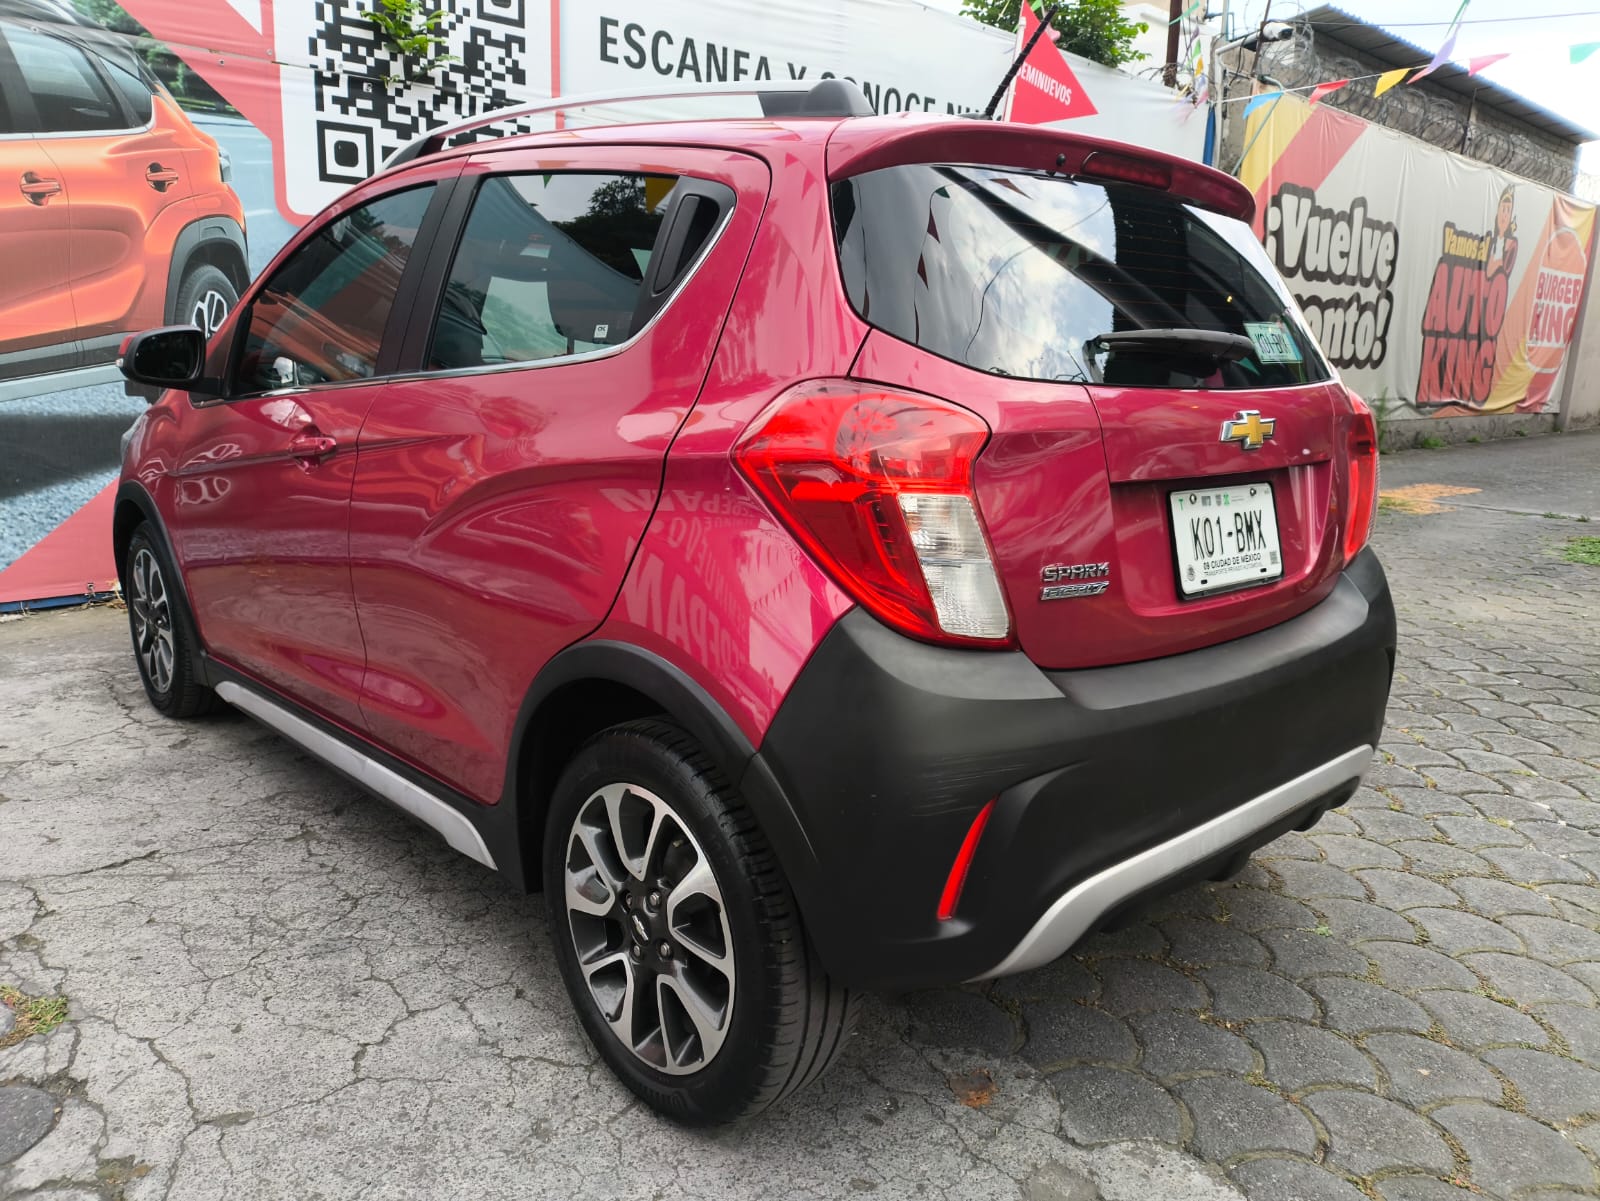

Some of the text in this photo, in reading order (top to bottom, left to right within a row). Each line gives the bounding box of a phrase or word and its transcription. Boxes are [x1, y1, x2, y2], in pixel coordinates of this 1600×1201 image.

[1422, 256, 1508, 338] AUTO
[1536, 272, 1583, 305] BURGER
[1294, 289, 1394, 370] onto!
[1416, 335, 1497, 408] KING
[1191, 509, 1267, 561] K01-BMX
[1041, 562, 1109, 582] SPARK
[1210, 557, 1231, 569] CIUDAD
[1232, 556, 1240, 565] DE
